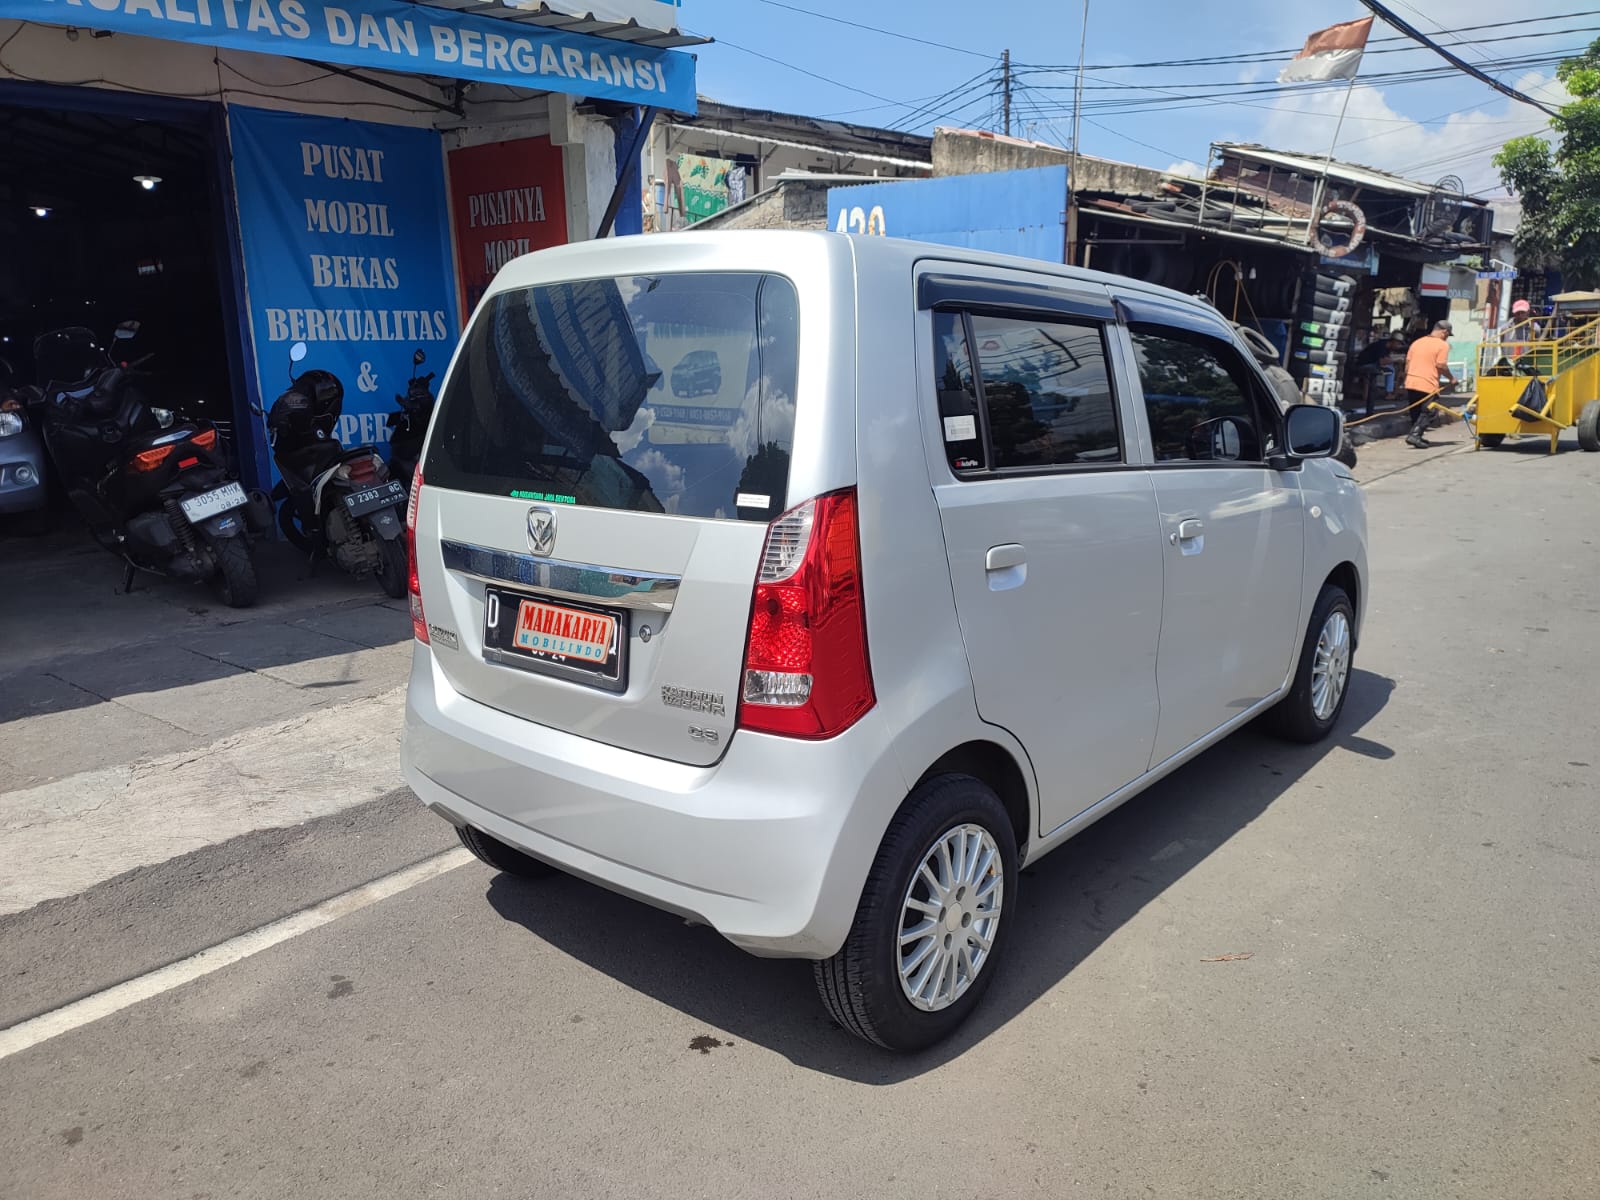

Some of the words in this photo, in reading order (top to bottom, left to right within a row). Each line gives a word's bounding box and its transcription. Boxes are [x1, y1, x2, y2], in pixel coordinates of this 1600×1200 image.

[324, 7, 419, 57] DAN
[430, 25, 667, 94] BERGARANSI
[301, 142, 384, 183] PUSAT
[304, 198, 394, 237] MOBIL
[468, 186, 546, 228] PUSATNYA
[309, 254, 399, 290] BEKAS
[265, 308, 447, 342] BERKUALITAS
[357, 361, 378, 392] &
[194, 491, 220, 507] 3055
[347, 498, 355, 507] D
[487, 594, 499, 628] D
[521, 604, 608, 645] MAHAKARYA
[520, 633, 602, 659] MOBILINDO
